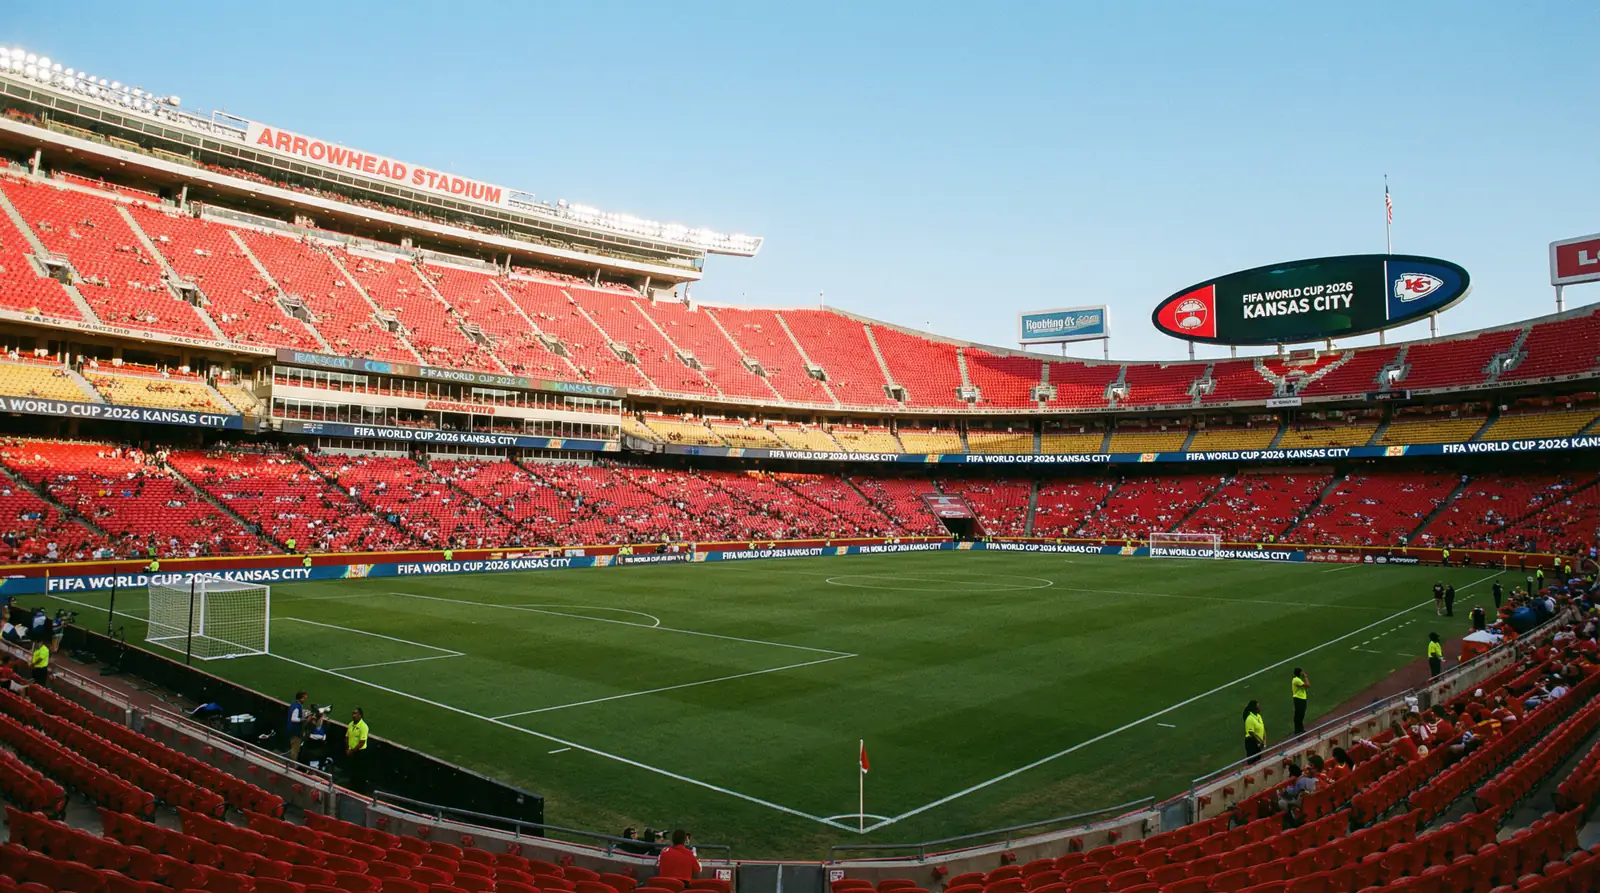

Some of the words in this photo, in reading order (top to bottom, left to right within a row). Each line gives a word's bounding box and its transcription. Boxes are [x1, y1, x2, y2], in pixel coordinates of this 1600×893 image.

[257, 128, 407, 180] ARROWHEAD
[411, 168, 502, 204] STADIUM
[1579, 249, 1600, 266] L
[1243, 292, 1264, 303] FIFA
[1265, 288, 1301, 301] WORLD
[1303, 285, 1324, 296] CUP
[1326, 281, 1353, 294] 2026
[1243, 298, 1310, 319] KANSAS
[1313, 293, 1353, 311] CITY
[443, 370, 475, 381] WORLD
[496, 376, 515, 385] 2026
[10, 398, 68, 414] WORLD
[71, 404, 101, 416] CUP
[103, 407, 140, 419] 2026
[143, 410, 197, 424] KANSAS
[200, 415, 229, 427] CITY
[353, 426, 376, 437] FIFA
[376, 428, 413, 439] WORLD
[414, 431, 433, 440] CUP
[435, 432, 459, 442] 2026
[460, 434, 496, 444] KANSAS
[498, 436, 518, 446] CITY
[1443, 443, 1466, 453] FIFA
[1468, 442, 1509, 453] WORLD
[1512, 440, 1536, 450] CUP
[1538, 438, 1569, 449] 2026
[769, 450, 785, 458] FIFA
[785, 450, 812, 459] WORLD
[813, 451, 829, 460] CUP
[829, 452, 848, 460] 2026
[849, 453, 880, 461] KANSAS
[881, 454, 899, 462] CITY
[966, 455, 984, 463] FIFA
[985, 455, 1015, 463] WORLD
[1016, 455, 1033, 463] CUP
[1034, 455, 1055, 463] 2026
[1056, 454, 1091, 463] KANSAS
[1092, 454, 1111, 463] CITY
[1186, 452, 1205, 461] FIFA
[1206, 451, 1239, 461] WORLD
[1241, 451, 1259, 460] CUP
[1261, 450, 1285, 459] 2026
[1286, 449, 1326, 458] KANSAS
[1327, 448, 1351, 457] CITY
[722, 551, 737, 560] FIFA
[737, 550, 759, 559] WORLD
[760, 549, 772, 558] CUP
[986, 542, 1000, 550] FIFA
[1025, 543, 1039, 551] CUP
[1057, 545, 1085, 553] KANSAS
[1086, 546, 1103, 554] CITY
[1151, 547, 1168, 556] FIFA
[1169, 548, 1195, 557] WORLD
[1198, 549, 1214, 557] CUP
[1236, 550, 1270, 559] KANSAS
[1271, 551, 1292, 560] CITY
[397, 564, 421, 575] FIFA
[422, 562, 461, 573] WORLD
[463, 561, 483, 571] CUP
[485, 560, 510, 570] 2026
[511, 559, 549, 569] KANSAS
[550, 558, 571, 568] CITY
[48, 578, 86, 591] FIFA
[88, 575, 148, 589] WORLD
[151, 573, 183, 586] CUP
[224, 569, 280, 581] KANSAS
[282, 568, 312, 579] CITY
